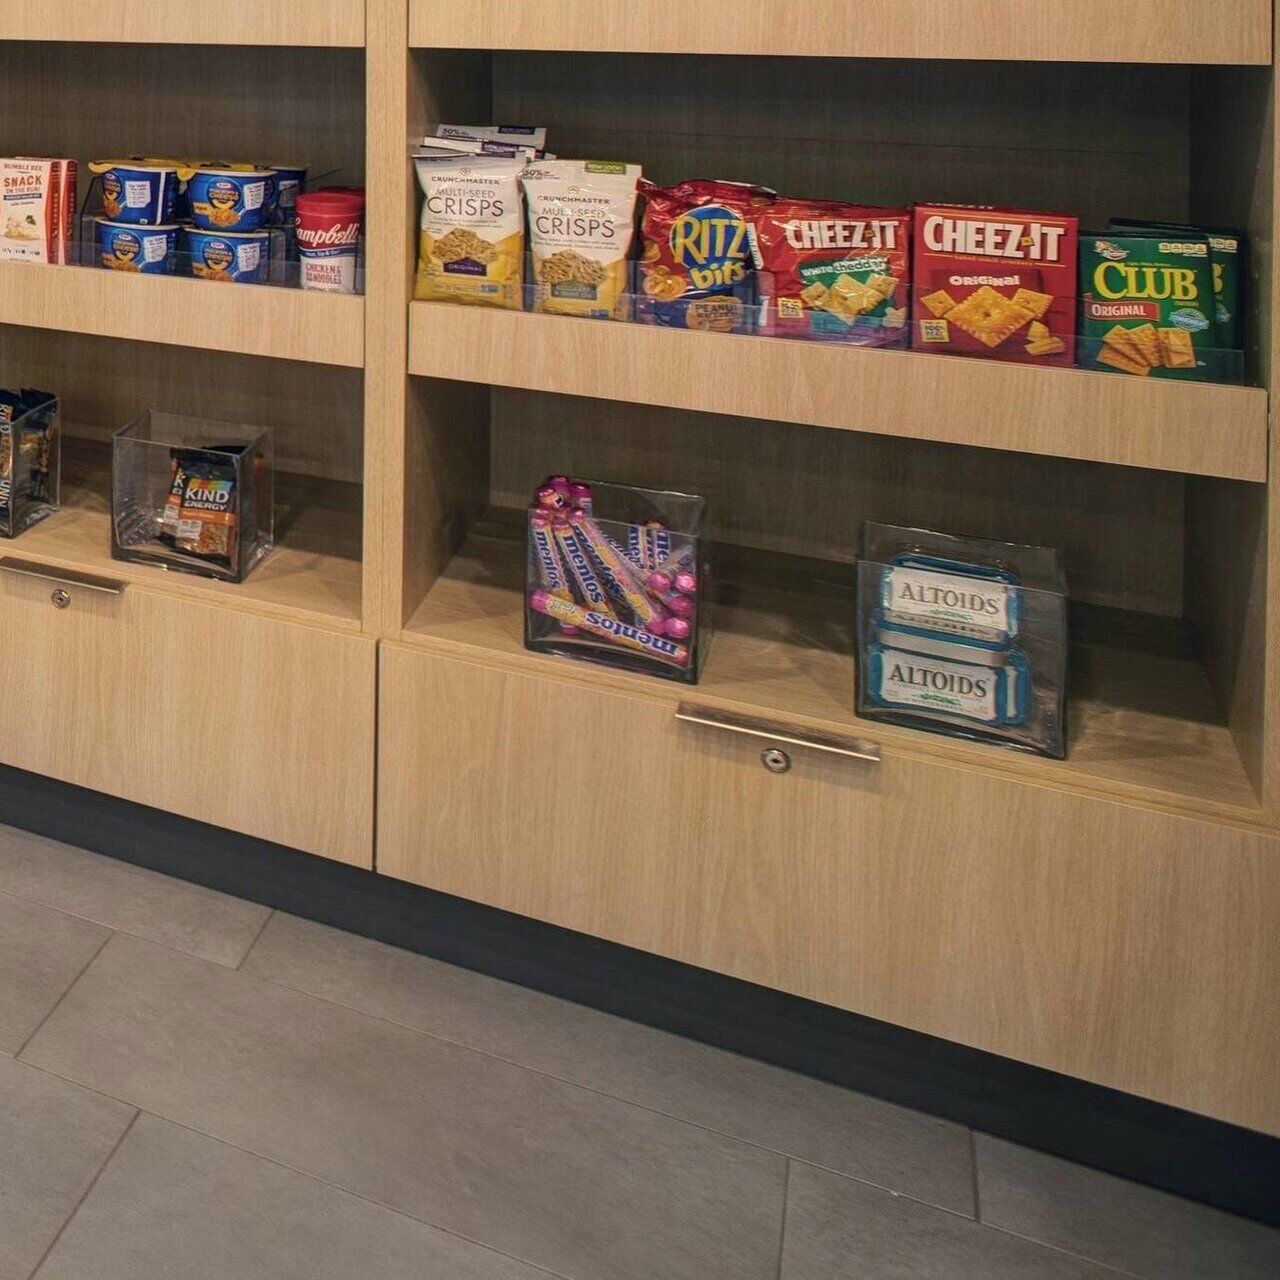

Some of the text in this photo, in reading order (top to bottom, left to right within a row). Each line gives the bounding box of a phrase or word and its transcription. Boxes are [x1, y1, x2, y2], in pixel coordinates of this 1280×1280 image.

[3, 175, 42, 188] SNACK
[431, 176, 500, 186] CRUNCHMASTER
[435, 188, 496, 199] MULTI-SEED
[538, 195, 611, 204] CRUNCHMASTER
[427, 196, 504, 217] CRISPS
[542, 207, 606, 219] MULTI-SEED
[536, 216, 615, 238] CRISPS
[786, 218, 900, 250] CHEEZ-IT
[922, 215, 1066, 261] CHEEZ-IT
[674, 219, 748, 262] RITZ
[691, 260, 745, 291] bits
[949, 273, 1021, 287] Original
[1092, 261, 1198, 301] CLUB
[1090, 302, 1147, 318] ORIGINAL
[184, 500, 228, 511] ENERGY
[185, 487, 229, 504] KIND
[536, 530, 561, 589] mentos
[565, 534, 605, 605] mentos
[898, 582, 1000, 616] ALTOIDS
[586, 611, 679, 656] mentos
[889, 664, 988, 699] ALTOIDS
